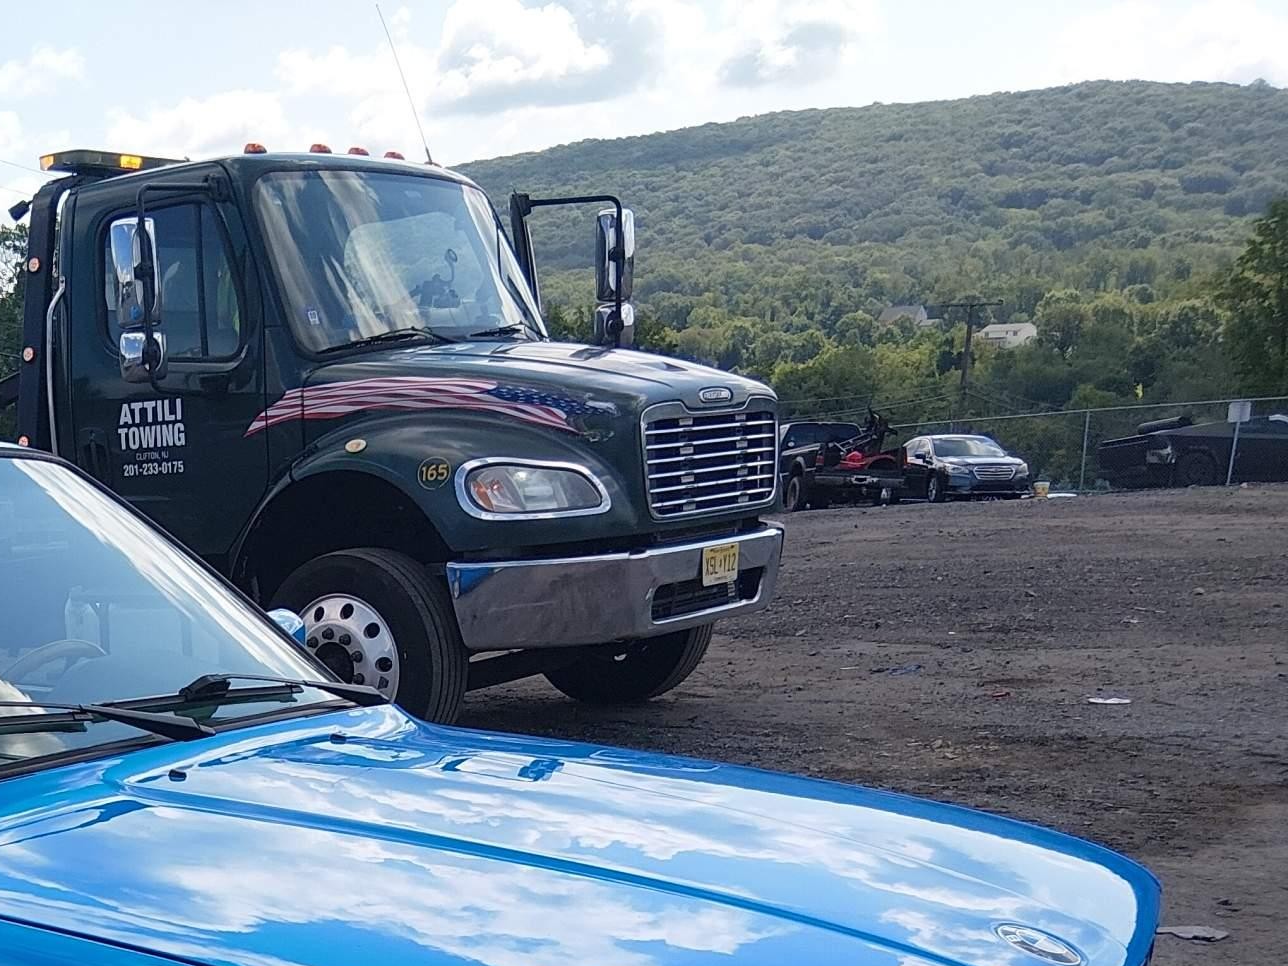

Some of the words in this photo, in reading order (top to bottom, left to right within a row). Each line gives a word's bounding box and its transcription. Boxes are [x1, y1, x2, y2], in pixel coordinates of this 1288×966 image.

[119, 398, 182, 425] ATTILI
[118, 423, 186, 450] TOWING
[421, 463, 448, 481] 165
